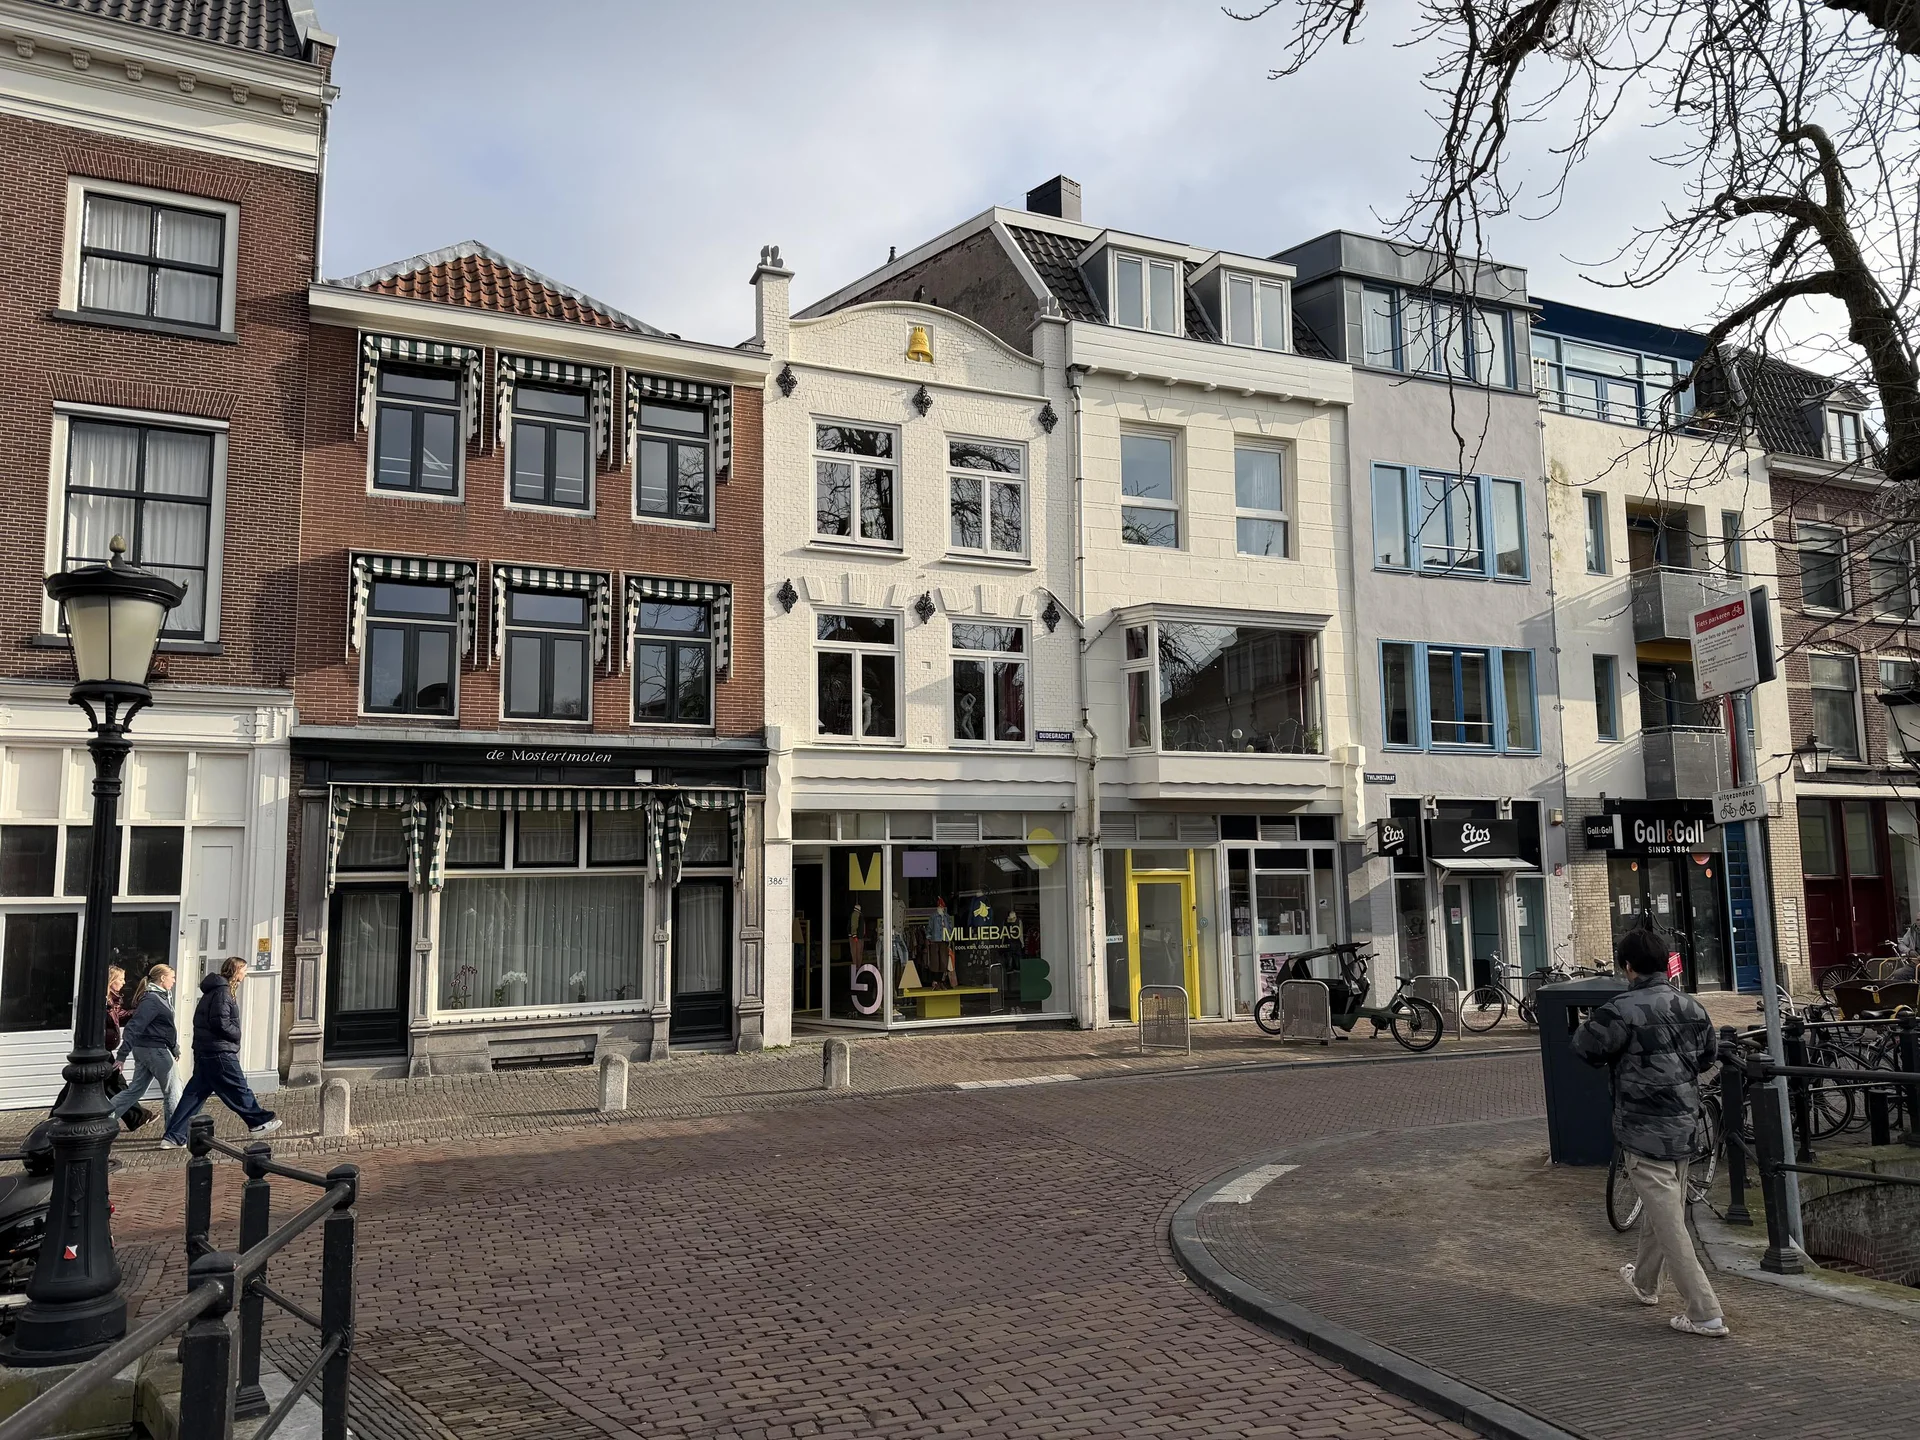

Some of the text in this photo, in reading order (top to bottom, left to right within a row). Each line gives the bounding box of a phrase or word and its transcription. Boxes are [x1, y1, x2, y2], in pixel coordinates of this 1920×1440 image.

[1696, 611, 1730, 628] Fiets parkeren
[486, 750, 612, 762] de Mostertmolen
[1718, 788, 1755, 801] uitgezonderd
[1383, 825, 1404, 843] Etos
[1461, 822, 1491, 844] Etos
[1634, 819, 1704, 843] Gall&Gall
